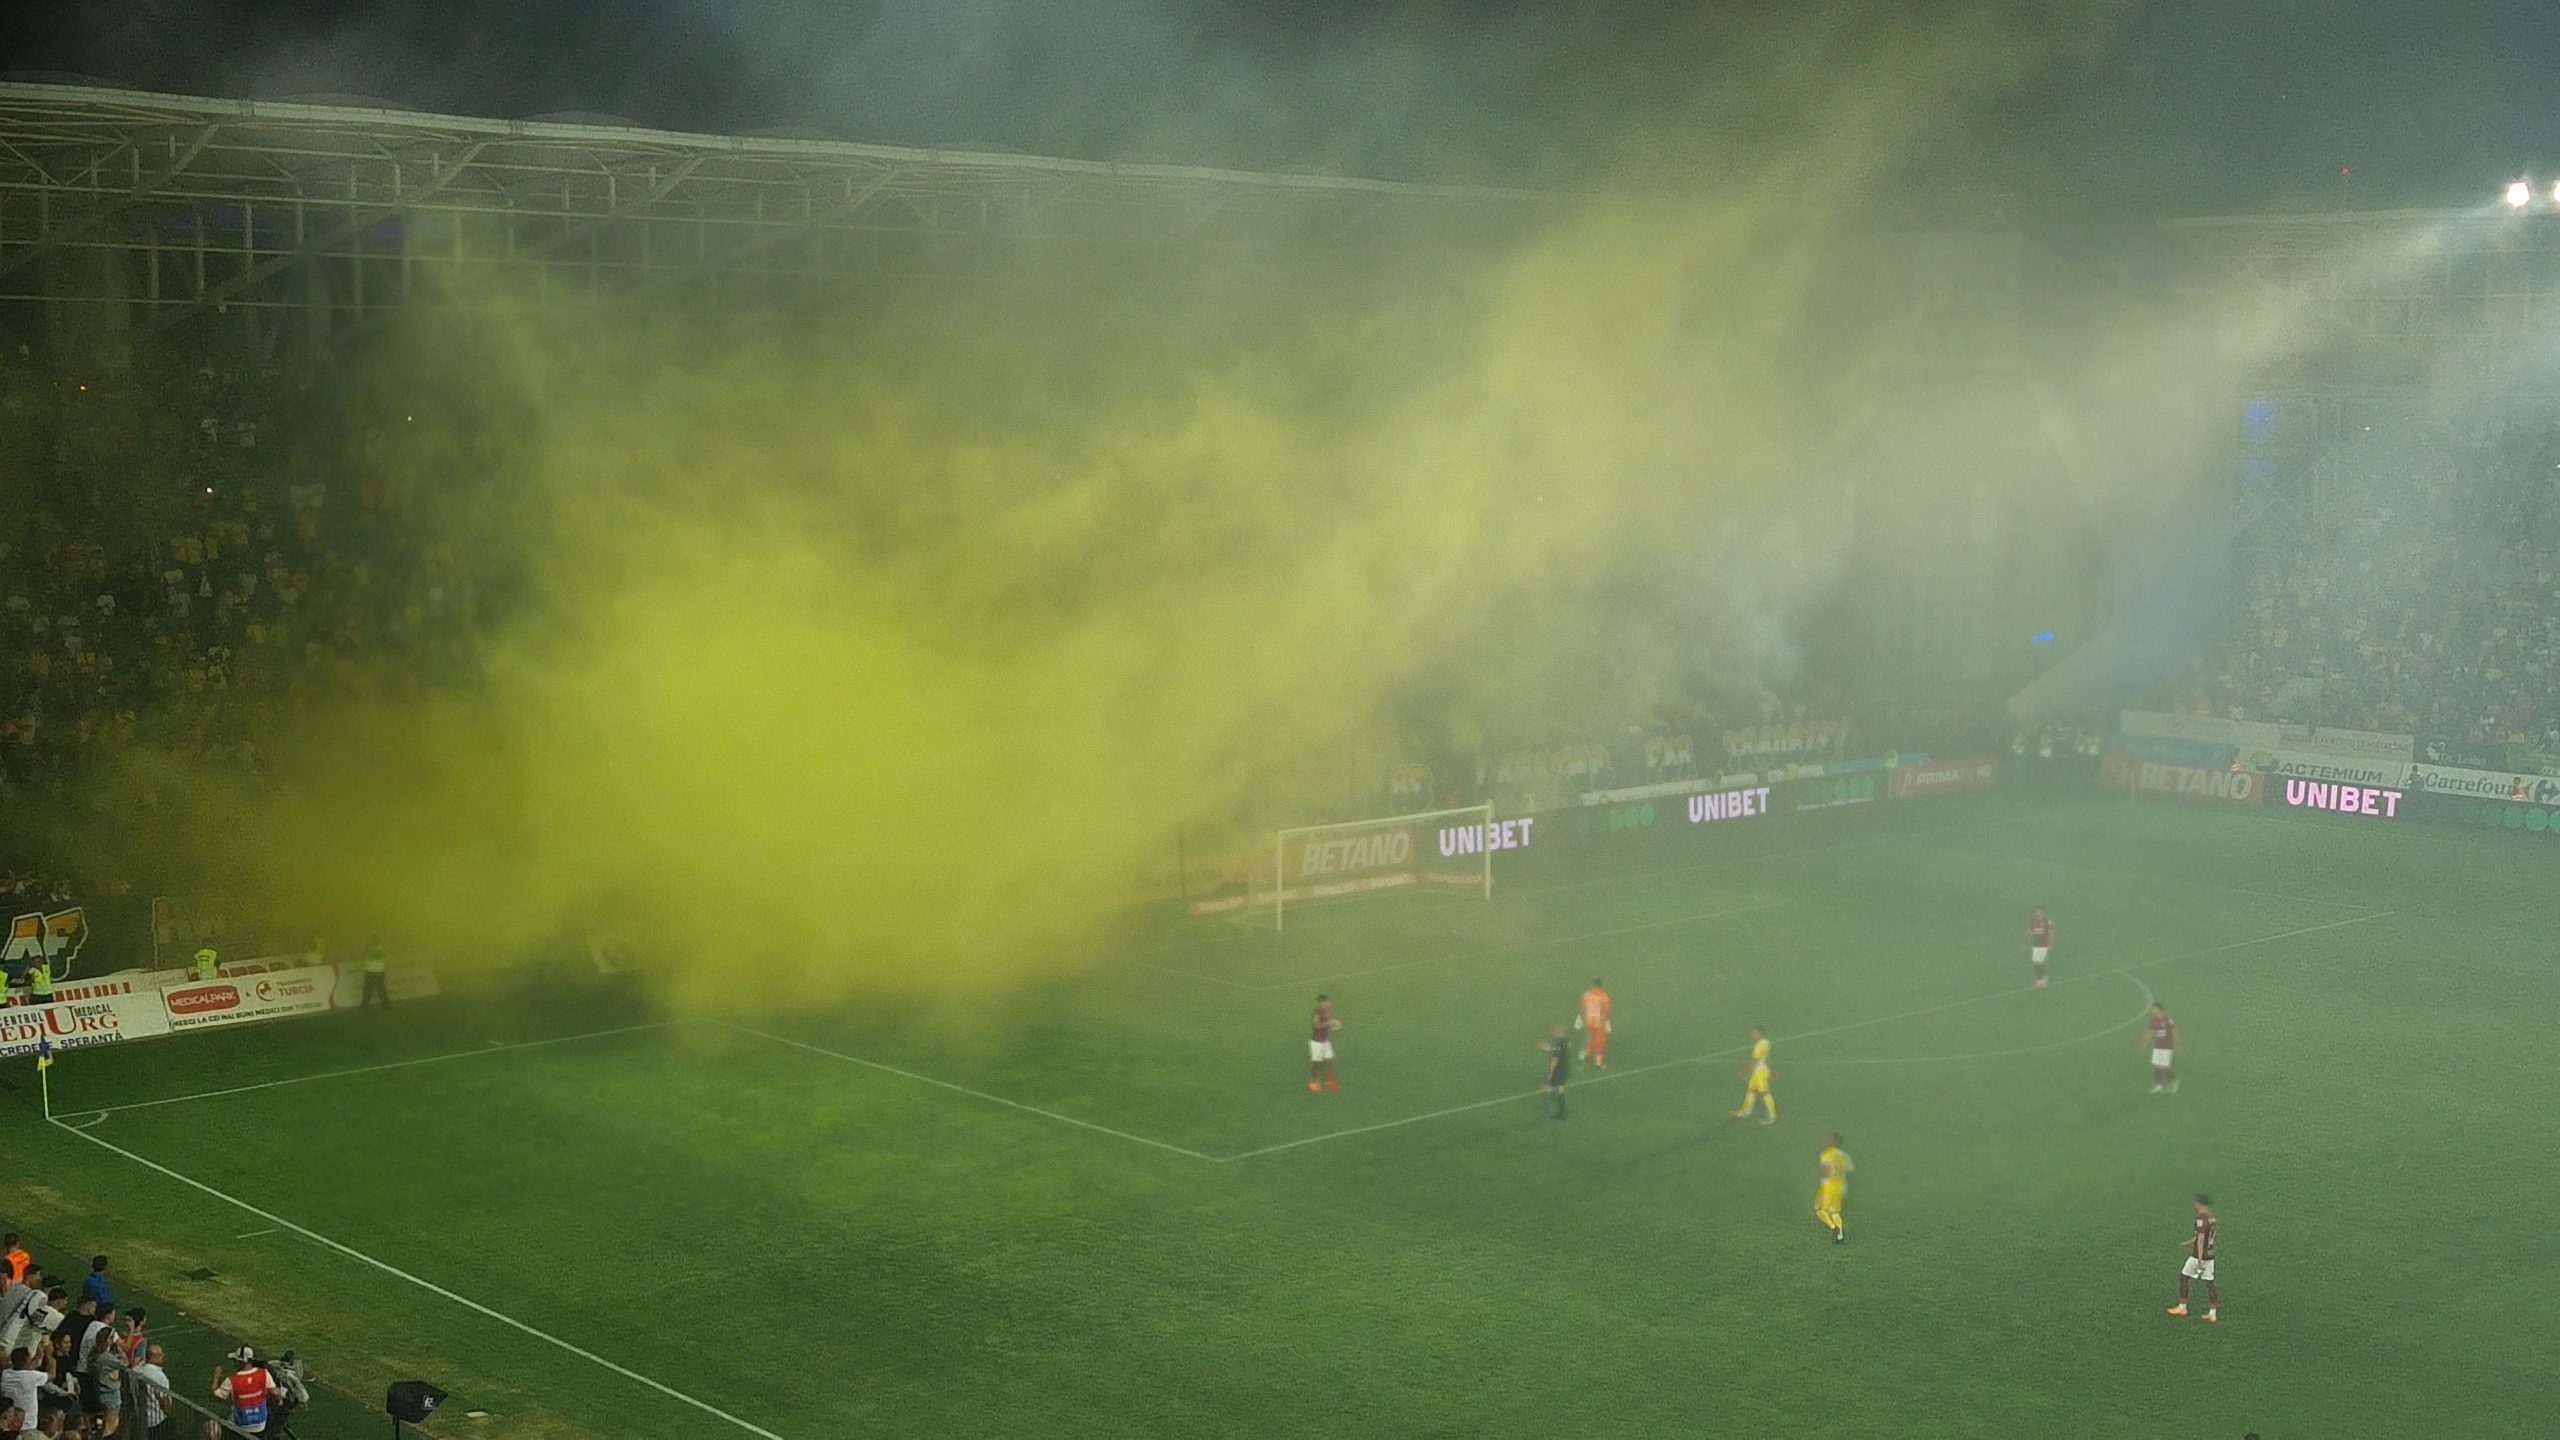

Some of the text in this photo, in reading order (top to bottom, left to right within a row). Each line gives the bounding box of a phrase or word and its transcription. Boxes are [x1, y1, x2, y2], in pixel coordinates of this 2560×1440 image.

[2139, 761, 2253, 800] BETANO
[2280, 762, 2383, 783] ACTEMIUM
[1688, 787, 1770, 823] UNIBET
[2286, 778, 2402, 818] UNIBET
[1302, 831, 1410, 878] BETANO
[1439, 818, 1533, 857] UNIBET
[74, 1004, 112, 1018] MEDICAL
